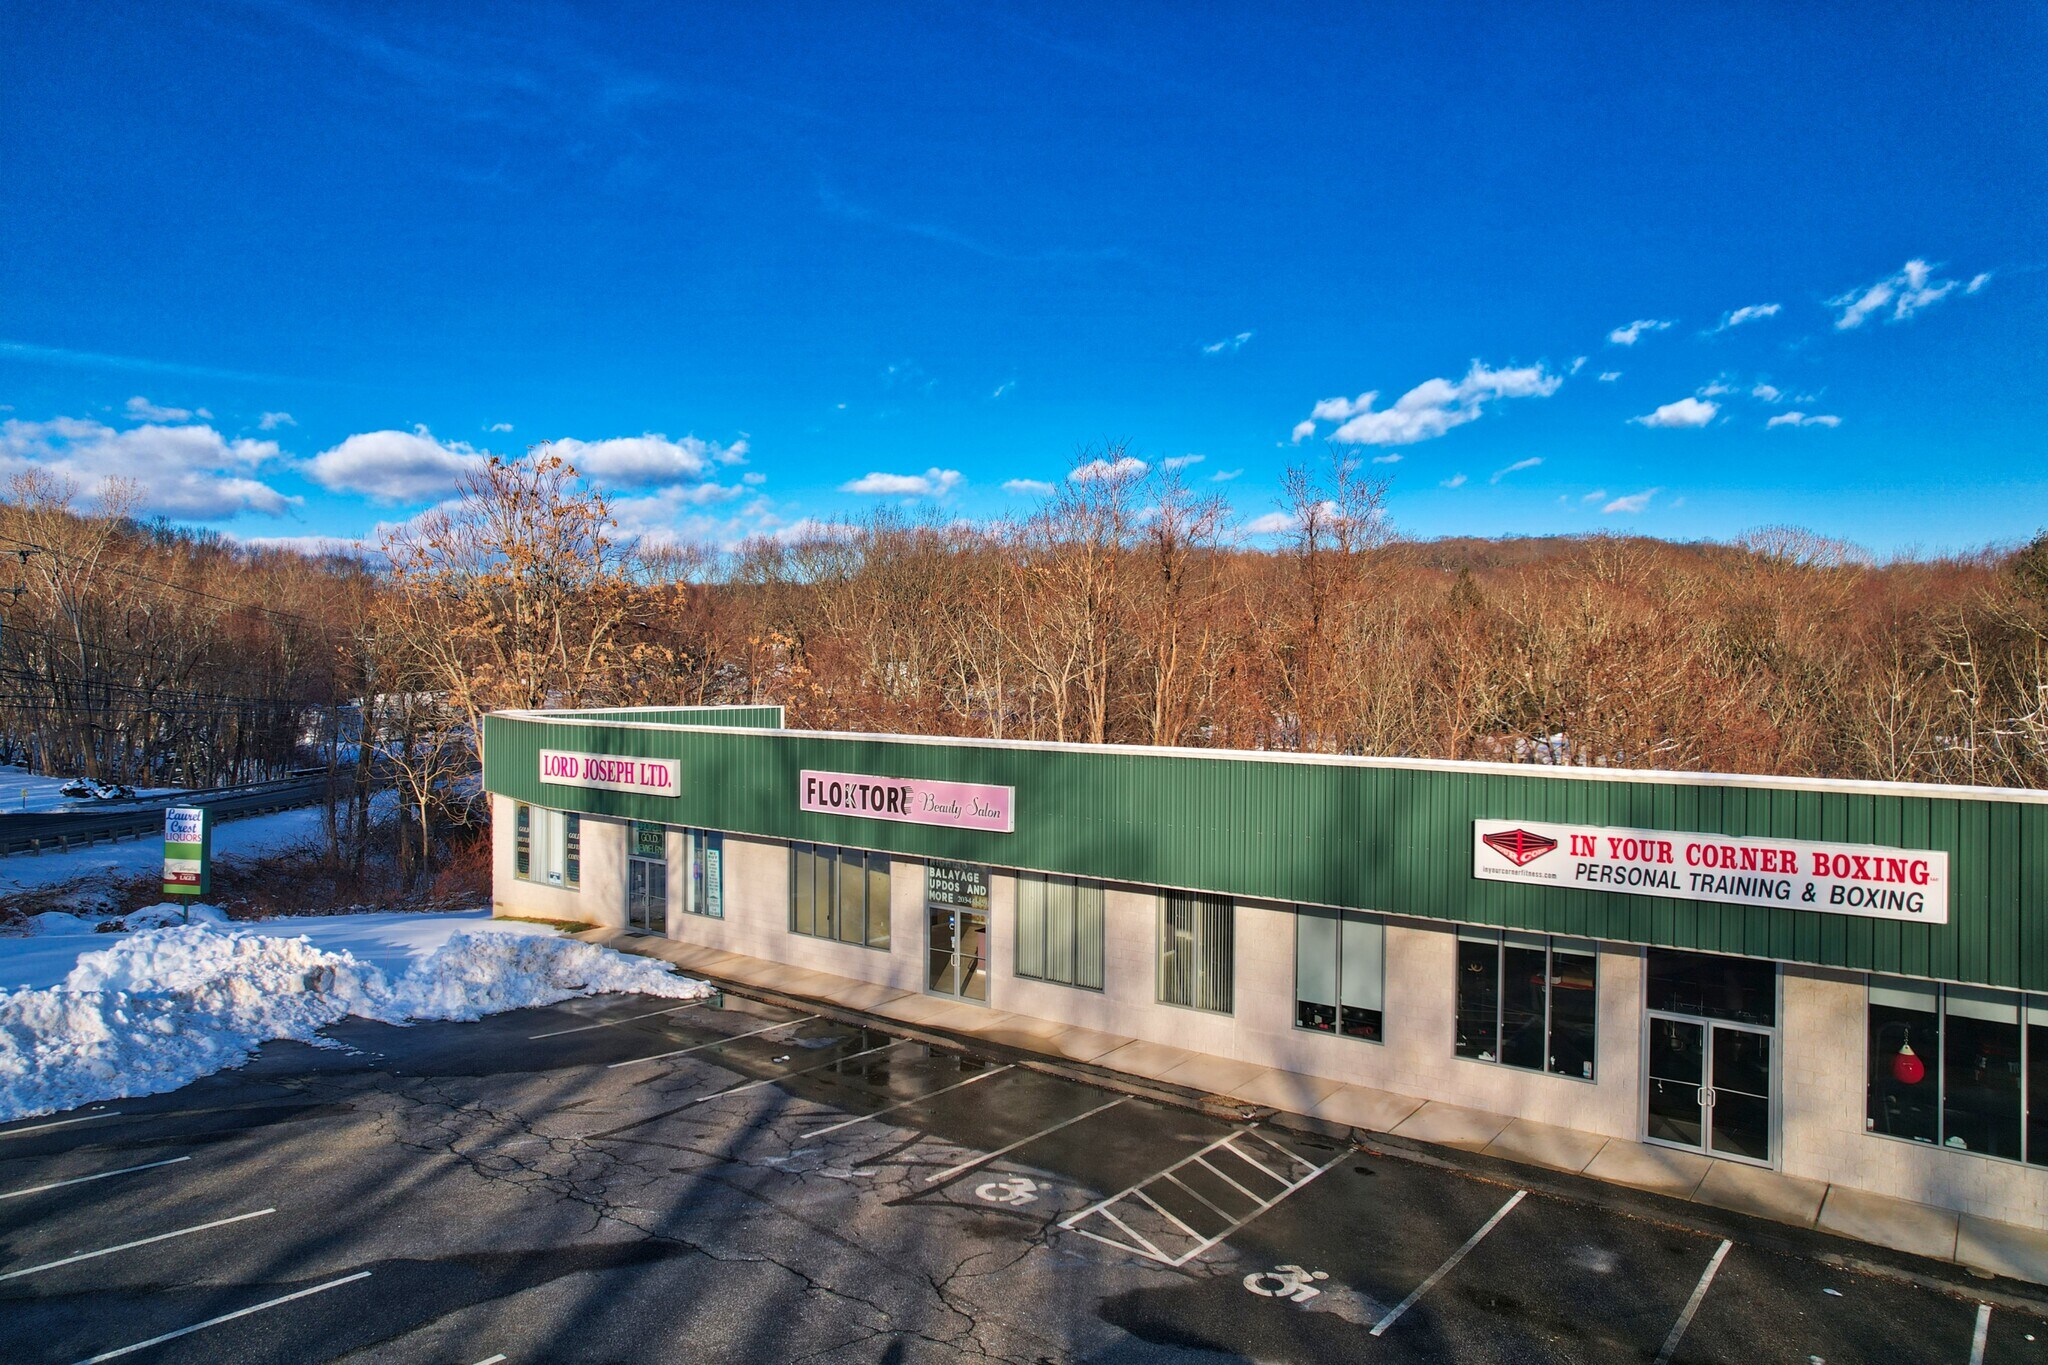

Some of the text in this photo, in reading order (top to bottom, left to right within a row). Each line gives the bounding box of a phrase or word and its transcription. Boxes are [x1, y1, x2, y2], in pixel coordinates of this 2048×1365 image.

[544, 755, 672, 788] LORD JOSEPH LTD.
[918, 791, 962, 819] Beauty
[965, 796, 1001, 818] Salon
[166, 809, 202, 821] Laurel
[170, 821, 197, 832] Crest
[166, 832, 202, 842] LIQUORS
[641, 833, 658, 843] GOLD
[1570, 835, 1597, 857] IN
[1608, 837, 1673, 864] YOUR
[1686, 843, 1798, 874] CORNER
[1812, 852, 1929, 885] BOXING
[929, 867, 979, 883] BALAYAGE
[1483, 866, 1557, 879] inyourcornerfitness.com
[929, 879, 987, 896] UPDOS AND
[1575, 863, 1924, 913] PERSONAL TRAINING & BOXING
[929, 890, 954, 903] MORE
